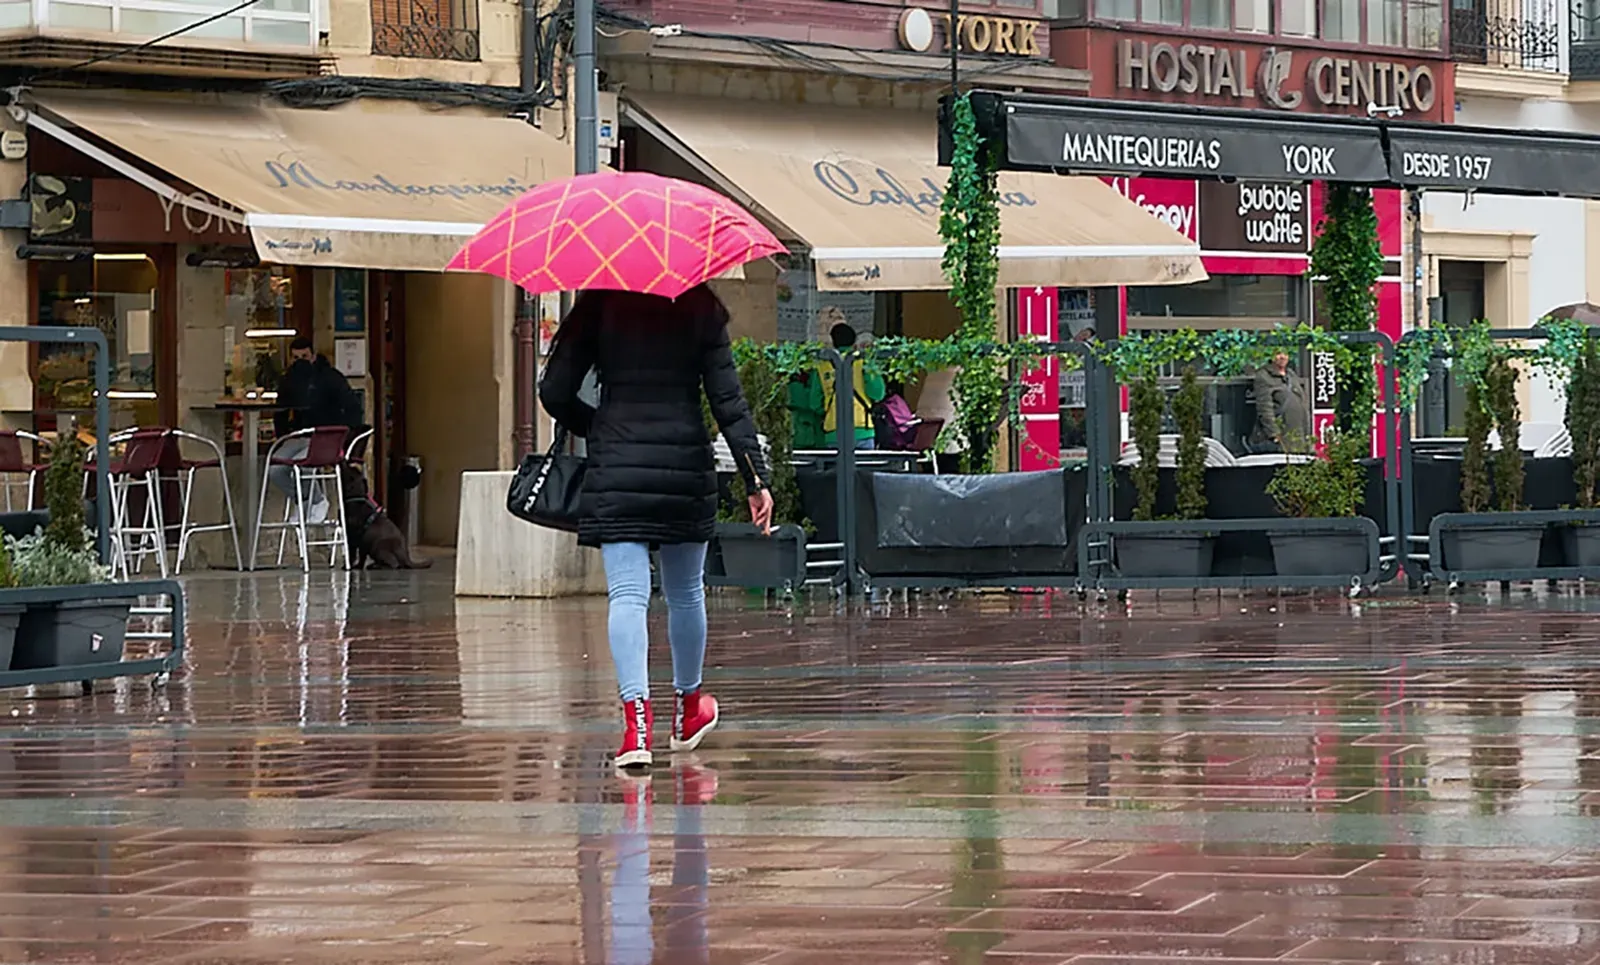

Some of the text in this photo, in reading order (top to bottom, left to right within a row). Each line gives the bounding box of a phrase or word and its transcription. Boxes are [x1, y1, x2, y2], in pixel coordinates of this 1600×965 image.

[943, 14, 1041, 55] YORK
[1117, 39, 1436, 112] HOSTAL CENTRO
[1063, 132, 1336, 174] MANTEQUERIAS YORK
[1403, 152, 1492, 180] DESDE 1957
[158, 191, 247, 234] YOR
[1238, 183, 1301, 216] bubble
[1246, 212, 1303, 243] waffle
[1315, 349, 1328, 402] bubbl
